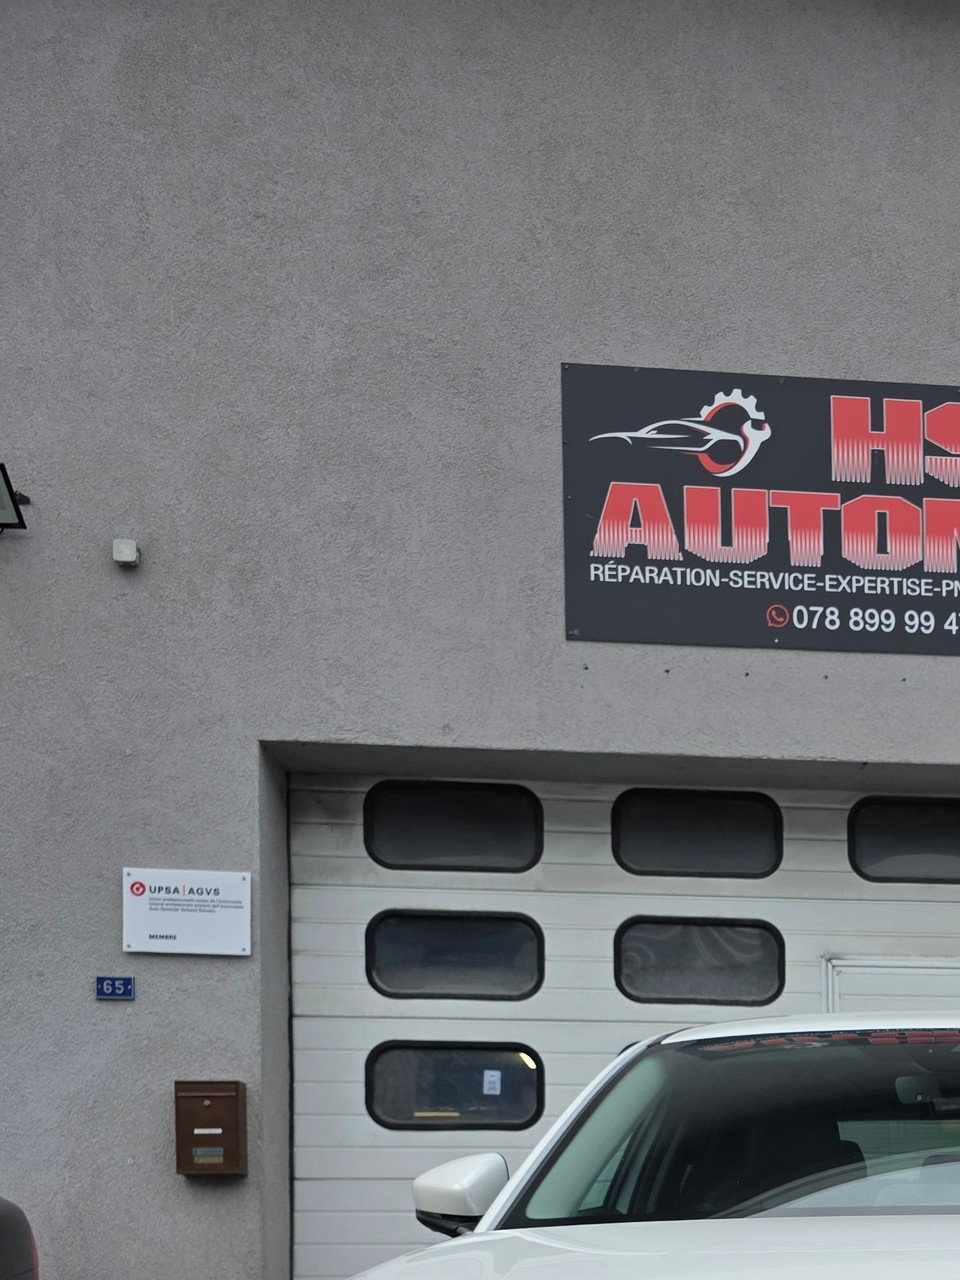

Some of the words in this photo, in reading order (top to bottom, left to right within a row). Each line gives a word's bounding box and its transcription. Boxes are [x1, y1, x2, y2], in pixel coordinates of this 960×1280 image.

[792, 605, 840, 630] 078
[849, 608, 896, 633] 899
[904, 610, 935, 634] 99
[149, 885, 180, 894] UPSA
[188, 887, 220, 896] AGVS
[103, 980, 124, 994] 65
